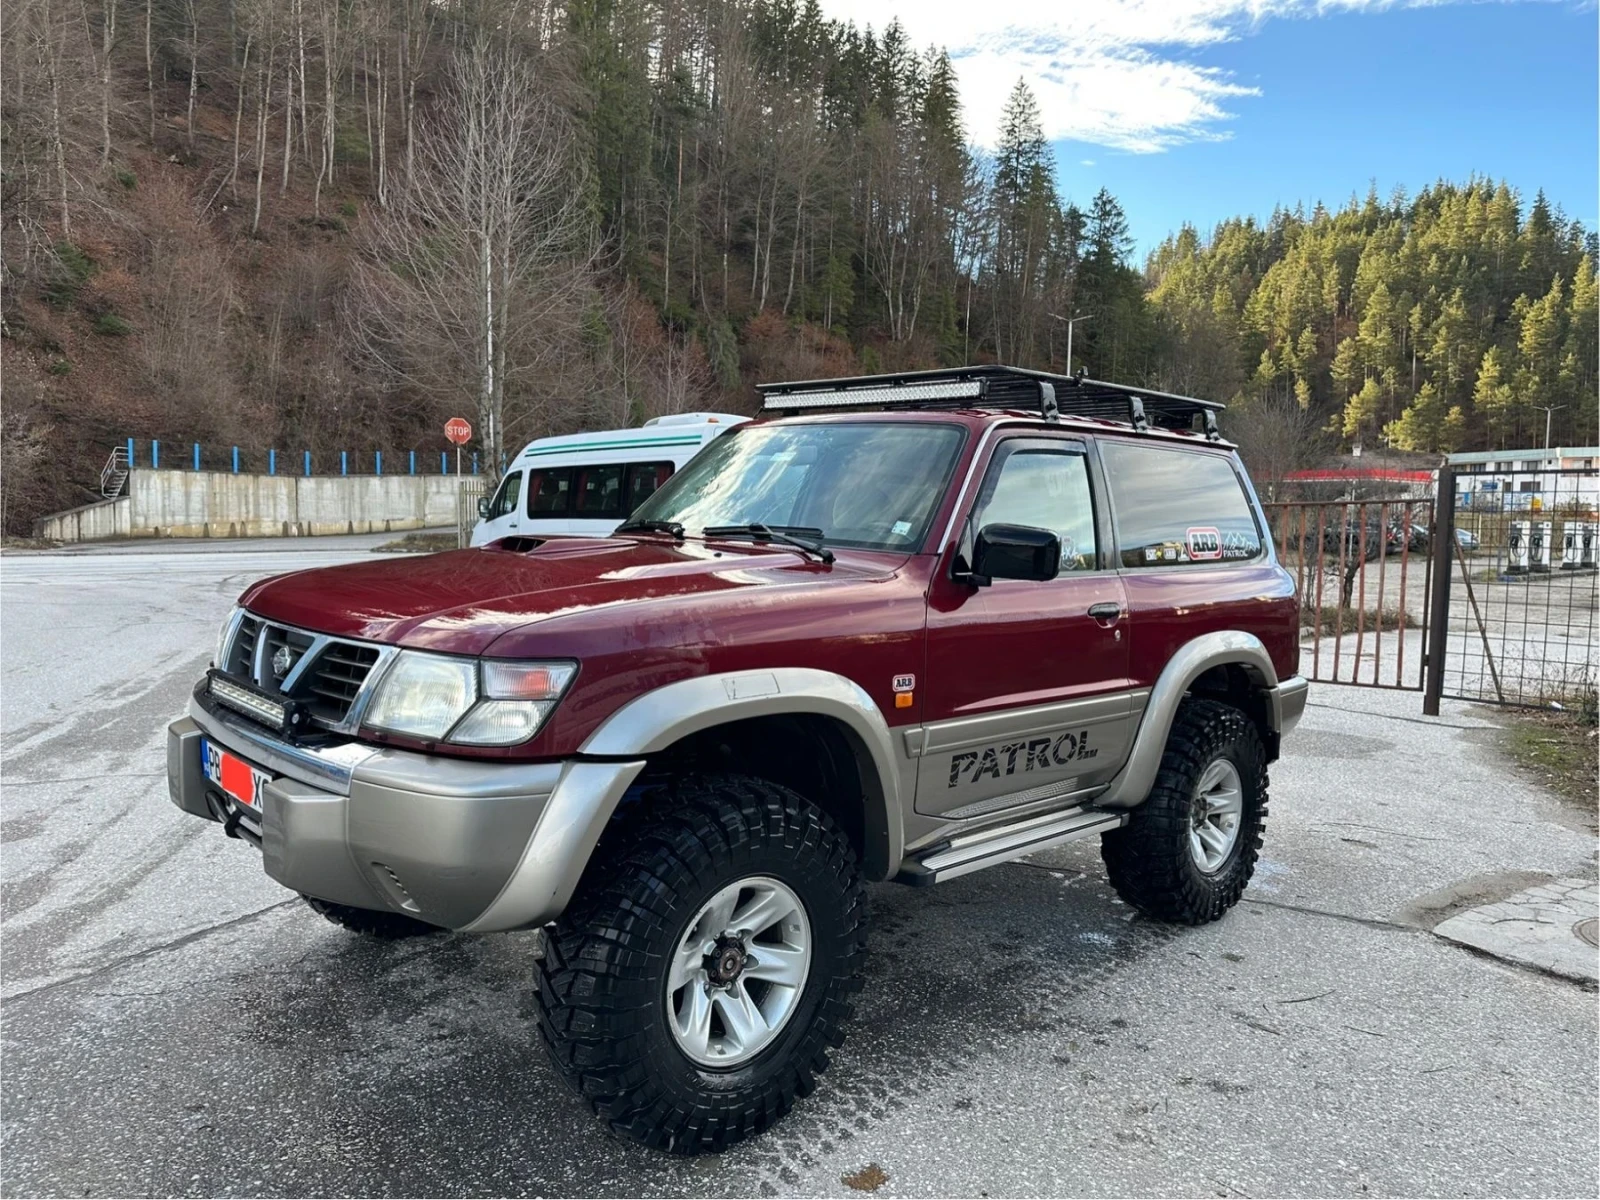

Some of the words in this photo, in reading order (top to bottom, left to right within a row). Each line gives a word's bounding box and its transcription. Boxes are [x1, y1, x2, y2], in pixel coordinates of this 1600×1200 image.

[447, 426, 469, 436] STOP
[1191, 533, 1219, 552] ARB
[1223, 550, 1249, 558] PATROL
[895, 677, 913, 688] ARB
[948, 731, 1098, 788] PATROL
